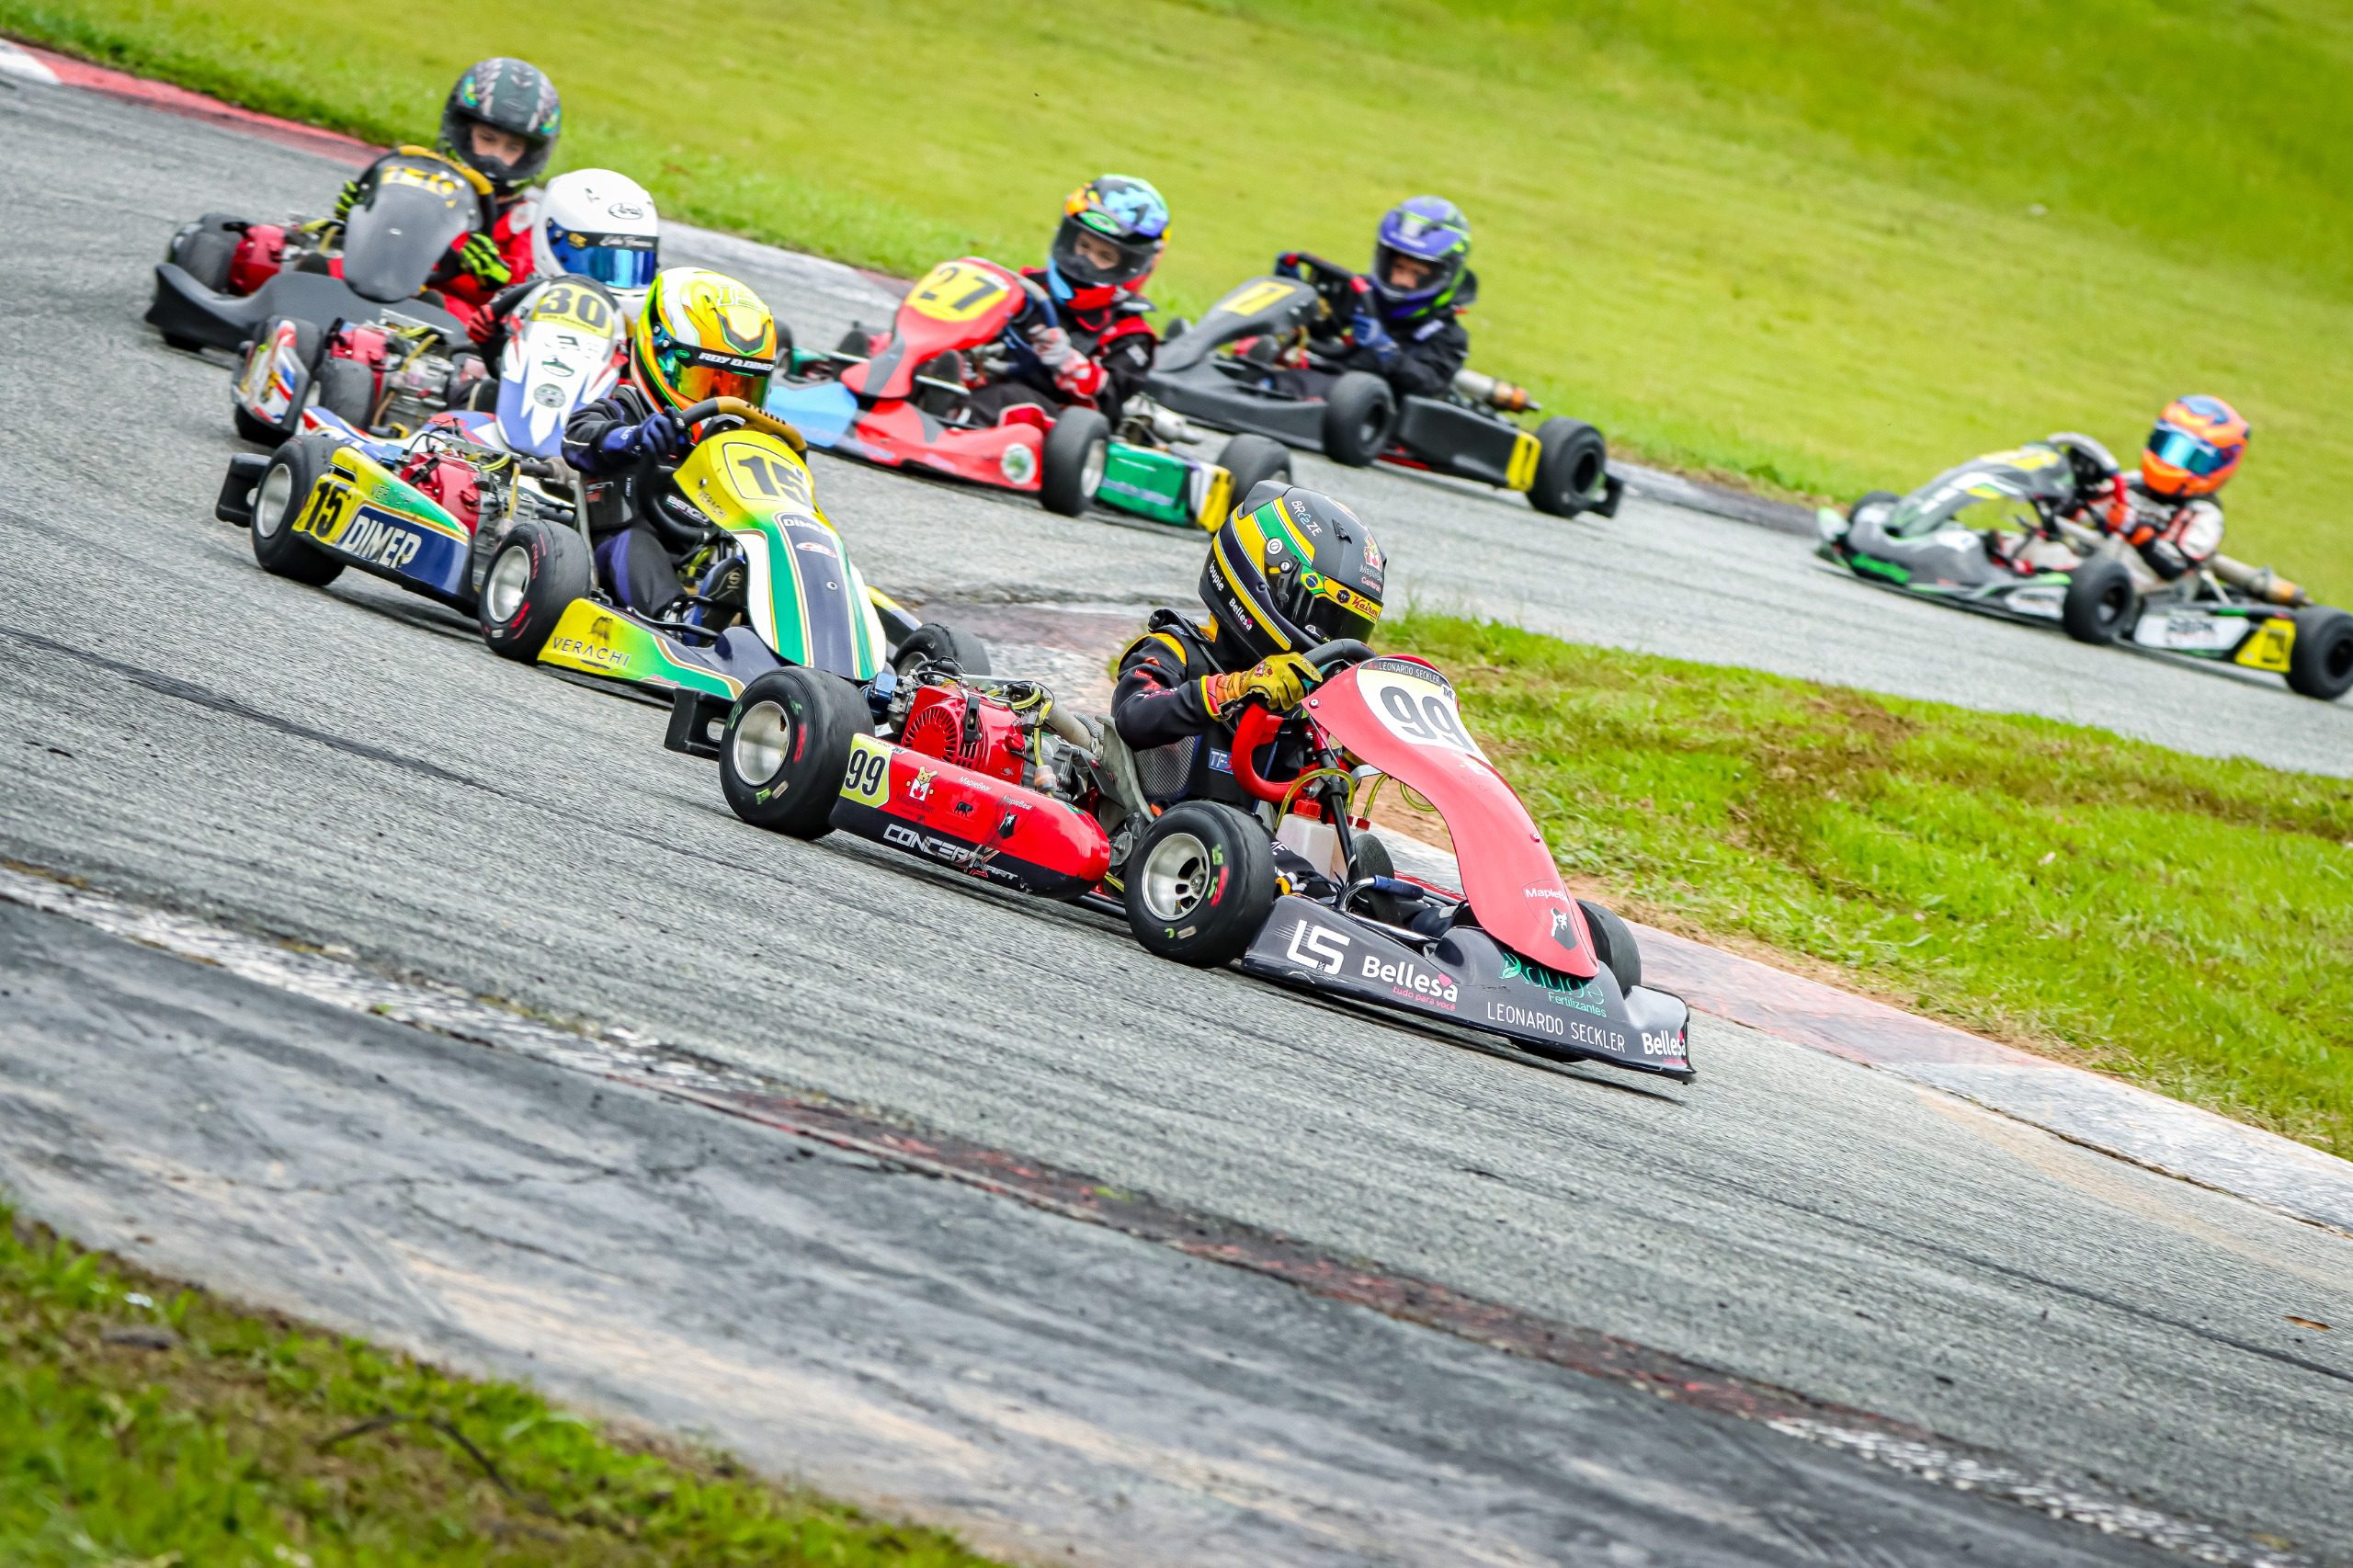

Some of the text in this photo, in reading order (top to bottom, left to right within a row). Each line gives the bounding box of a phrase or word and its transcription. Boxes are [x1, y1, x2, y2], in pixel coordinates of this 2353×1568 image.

[538, 288, 607, 329] 30
[919, 267, 999, 312] 27
[738, 456, 815, 509] 15
[304, 480, 352, 538] 15
[342, 515, 422, 570] DIMEP
[1228, 597, 1253, 631] Bellesa
[552, 637, 631, 667] VERACHI
[1379, 661, 1440, 684] LEONARDO SECKLER
[1381, 686, 1474, 752] 99
[845, 748, 886, 797] 99
[958, 776, 992, 792] MapleBear
[1003, 795, 1033, 811] MapleBear
[1362, 955, 1459, 1003] Bellesa
[1392, 985, 1414, 999] tudo
[1415, 993, 1435, 1007] para
[1548, 992, 1607, 1017] Fertilizantes
[1487, 1001, 1626, 1053] LEONARDO SECKLER
